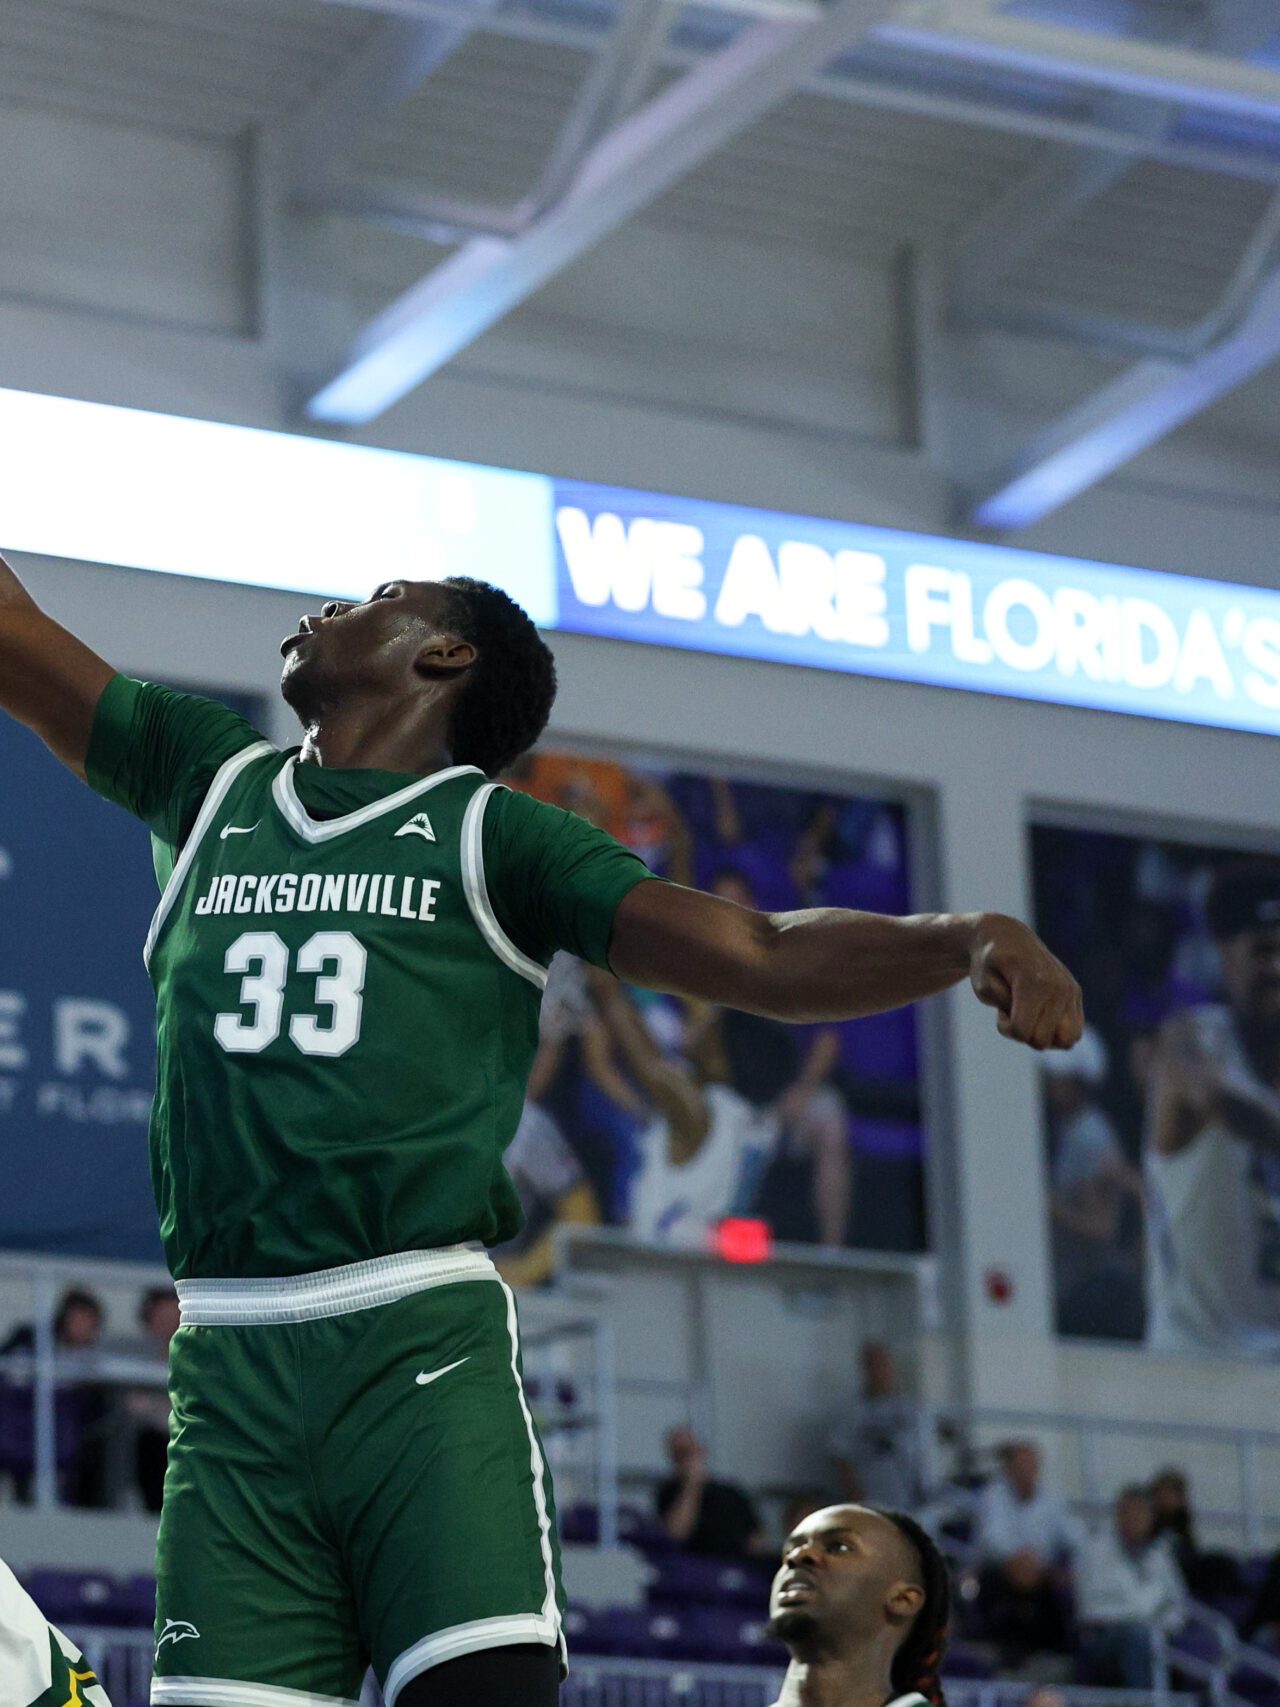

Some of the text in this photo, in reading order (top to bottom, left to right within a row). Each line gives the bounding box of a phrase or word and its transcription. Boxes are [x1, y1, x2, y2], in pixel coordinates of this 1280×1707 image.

[556, 506, 1280, 709] WE ARE FLORIDA'S
[195, 873, 441, 922] JACKSONVILLE
[213, 931, 368, 1058] 33
